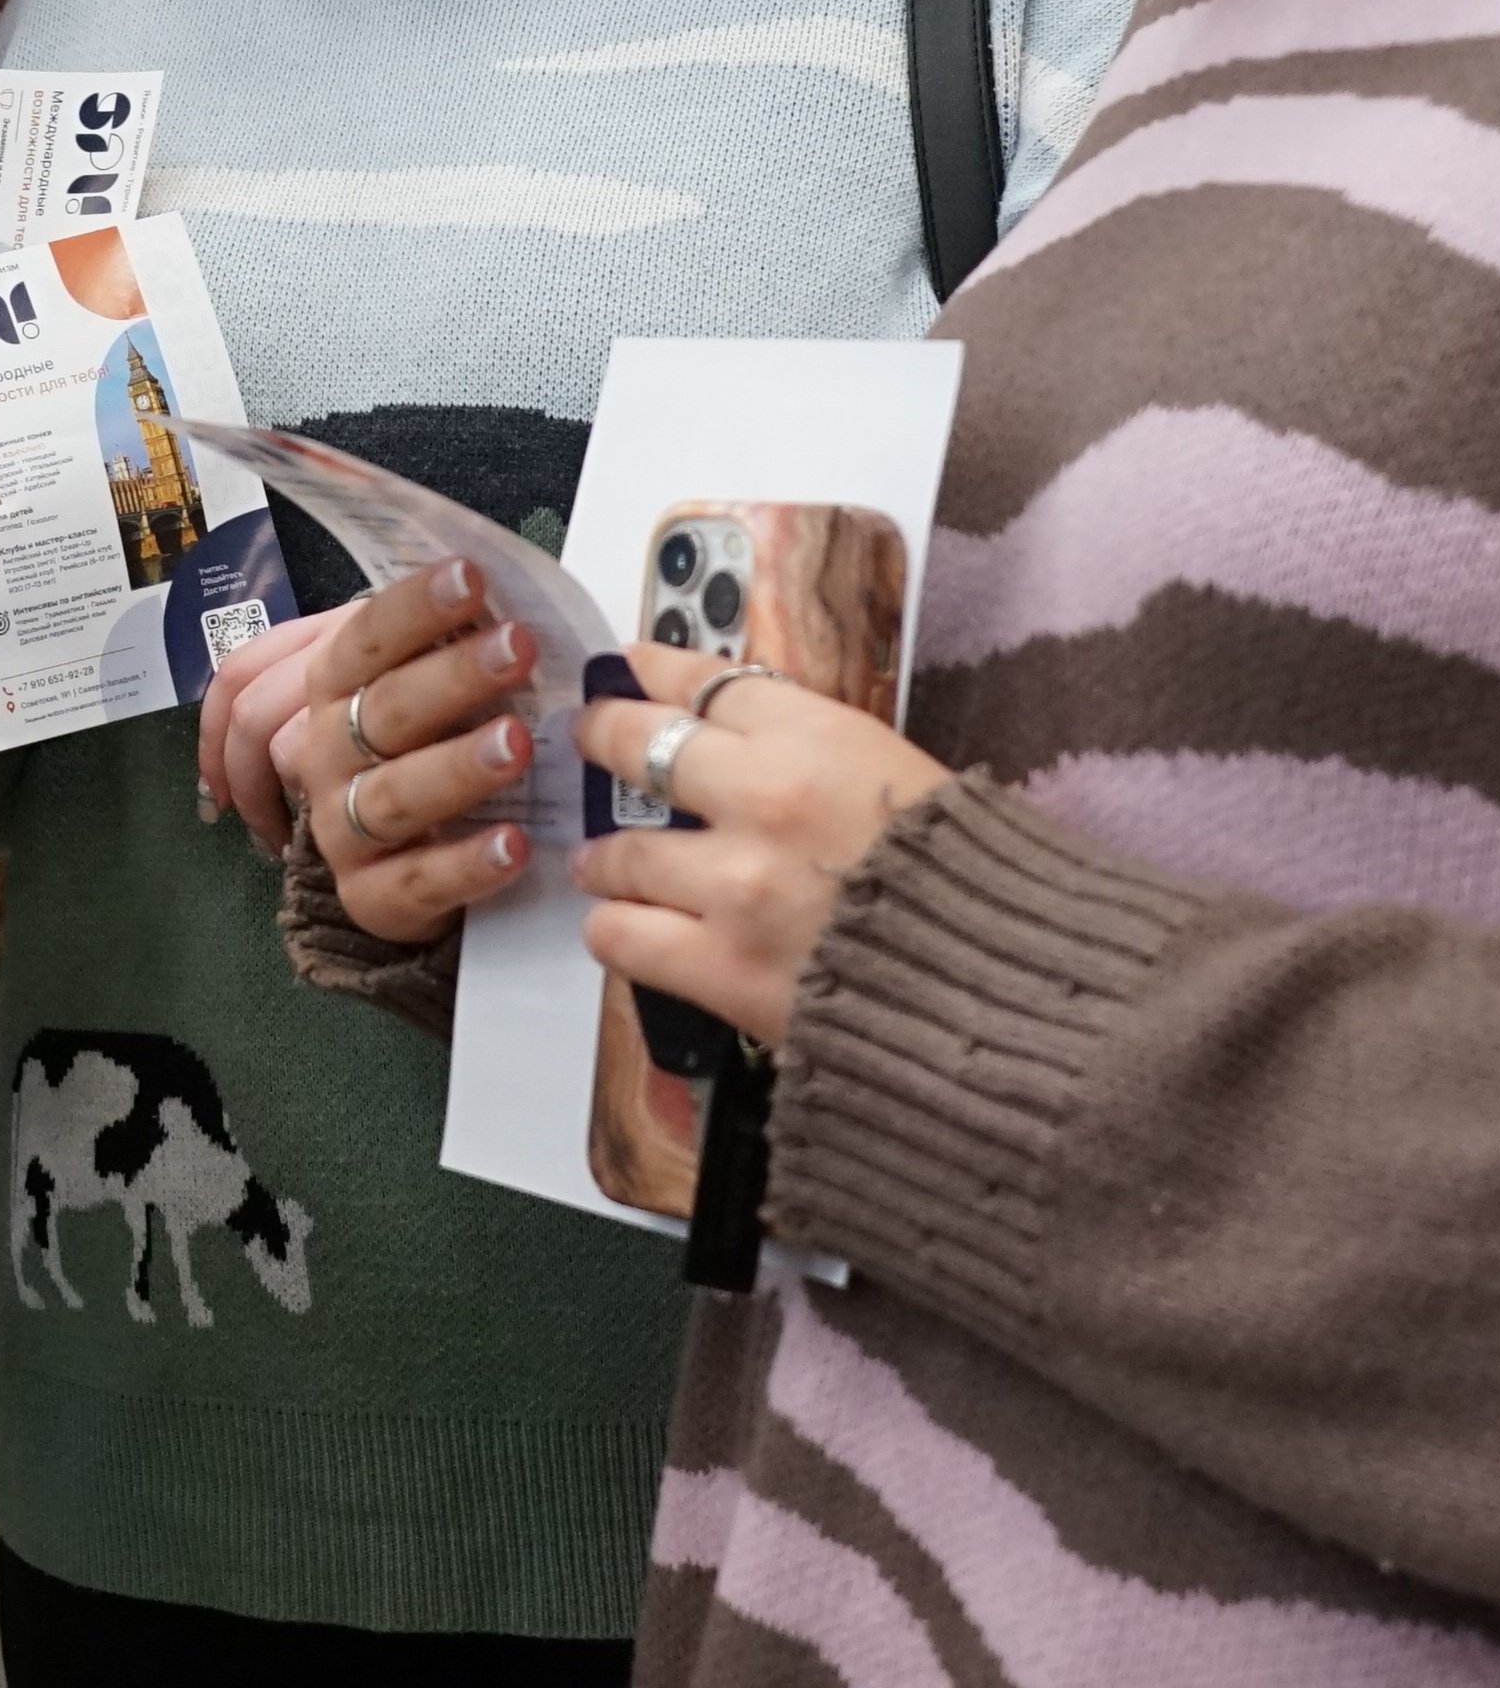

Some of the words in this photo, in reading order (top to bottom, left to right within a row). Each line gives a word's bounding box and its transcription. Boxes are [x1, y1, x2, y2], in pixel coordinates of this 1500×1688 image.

[19, 88, 44, 192] возможности
[33, 89, 64, 217] Международные
[15, 194, 31, 223] для
[37, 374, 68, 394] для
[69, 363, 111, 387] тебя!
[30, 677, 46, 689] 910
[46, 664, 95, 686] 652-92-28
